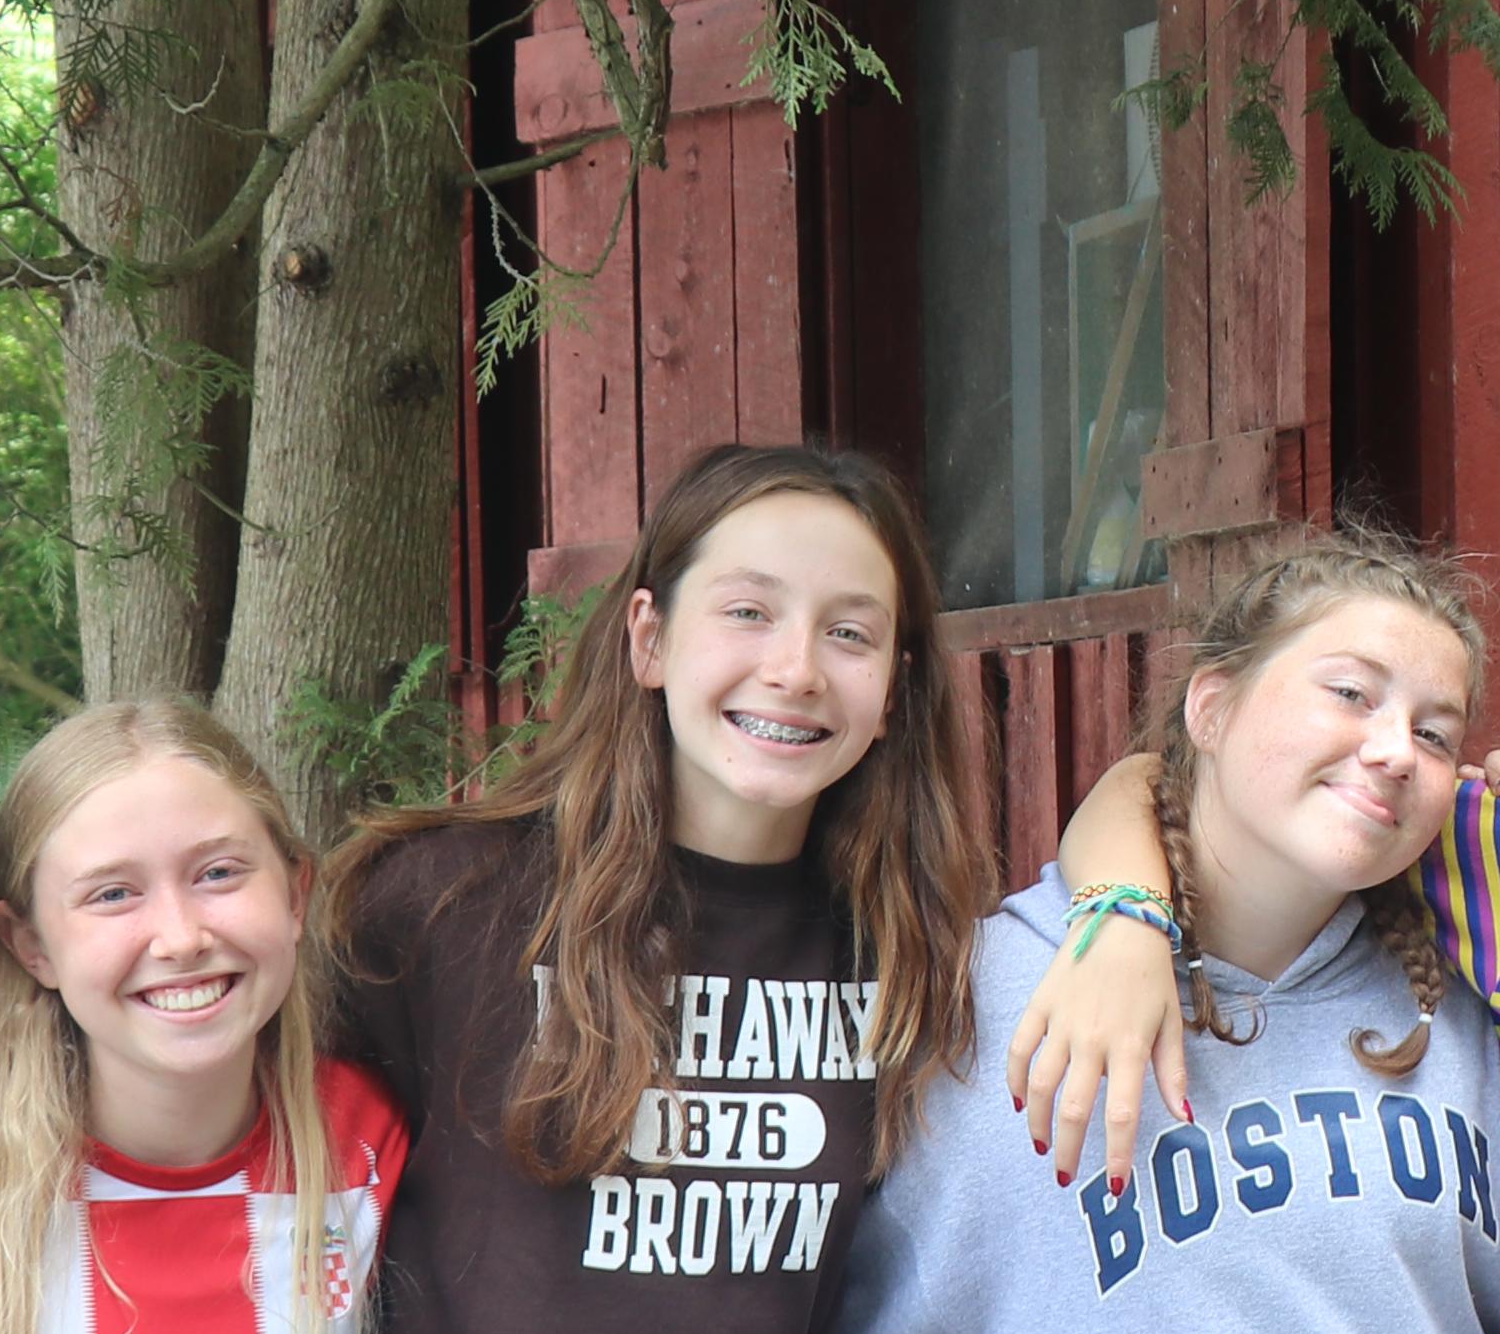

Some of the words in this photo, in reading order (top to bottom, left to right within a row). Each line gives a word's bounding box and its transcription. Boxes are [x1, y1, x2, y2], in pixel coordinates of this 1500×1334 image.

[655, 1096, 787, 1161] 1876
[582, 1174, 840, 1276] BROWN
[1077, 1087, 1500, 1300] BOSTON
